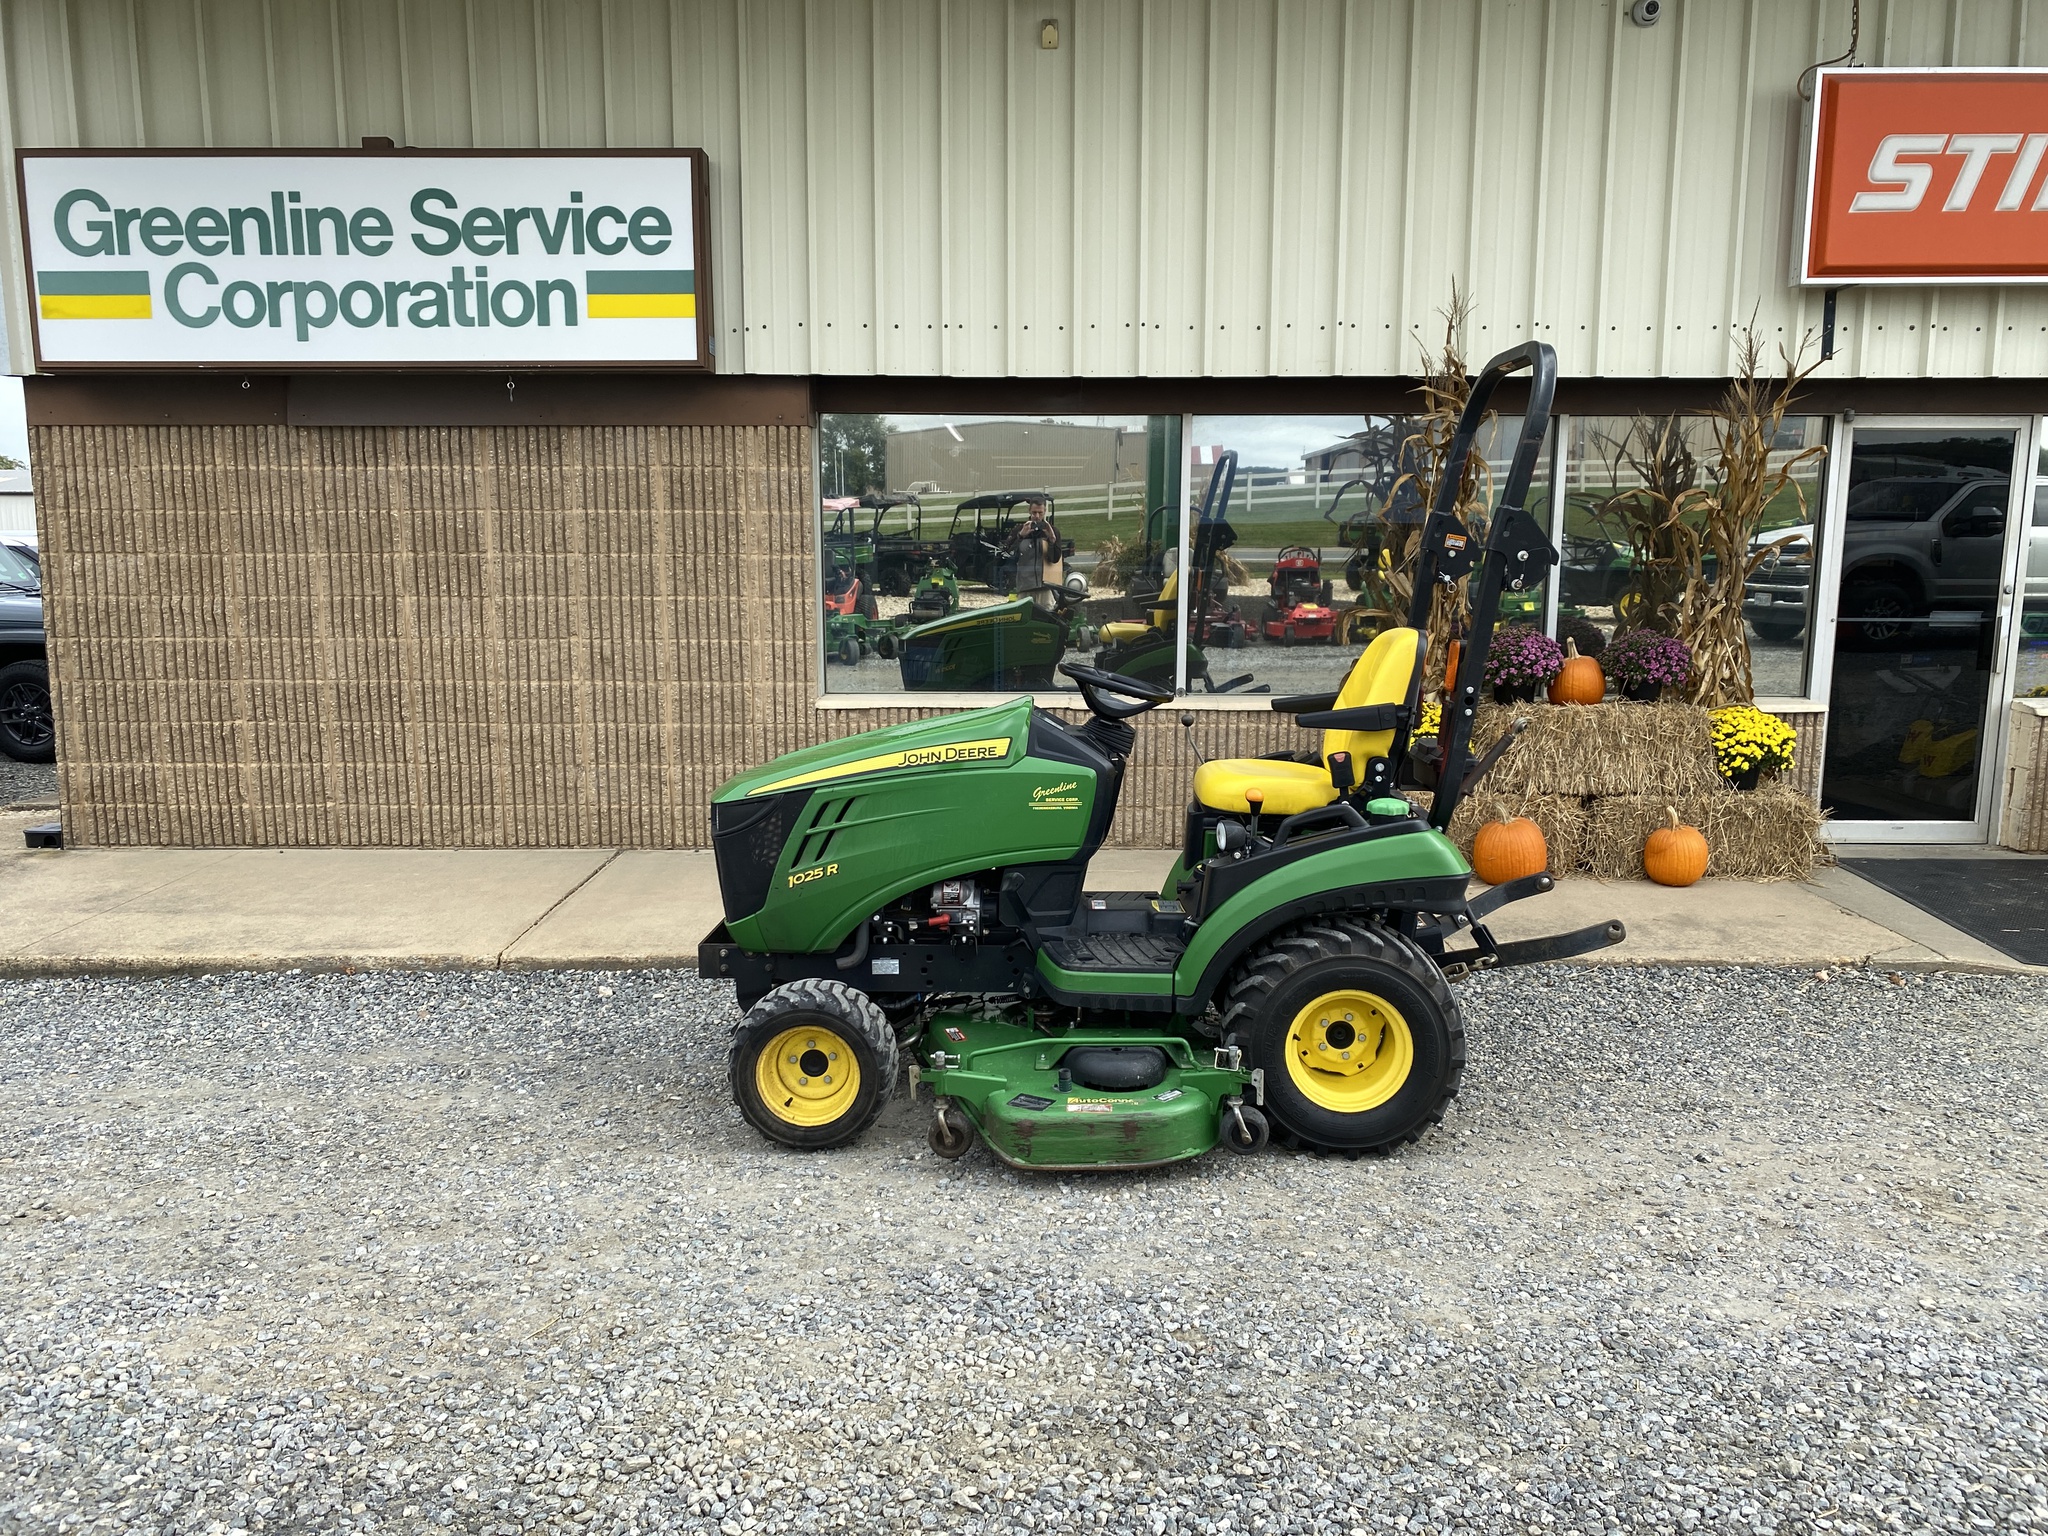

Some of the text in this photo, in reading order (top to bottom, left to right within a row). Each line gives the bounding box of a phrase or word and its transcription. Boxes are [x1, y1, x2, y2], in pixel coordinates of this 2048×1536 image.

[1848, 133, 2048, 213] STI
[54, 187, 672, 257] Greenline Service
[164, 262, 578, 342] Corporation
[898, 746, 997, 766] JOHN DEERE
[1032, 781, 1078, 802] Greenline
[787, 863, 839, 888] 1025 R
